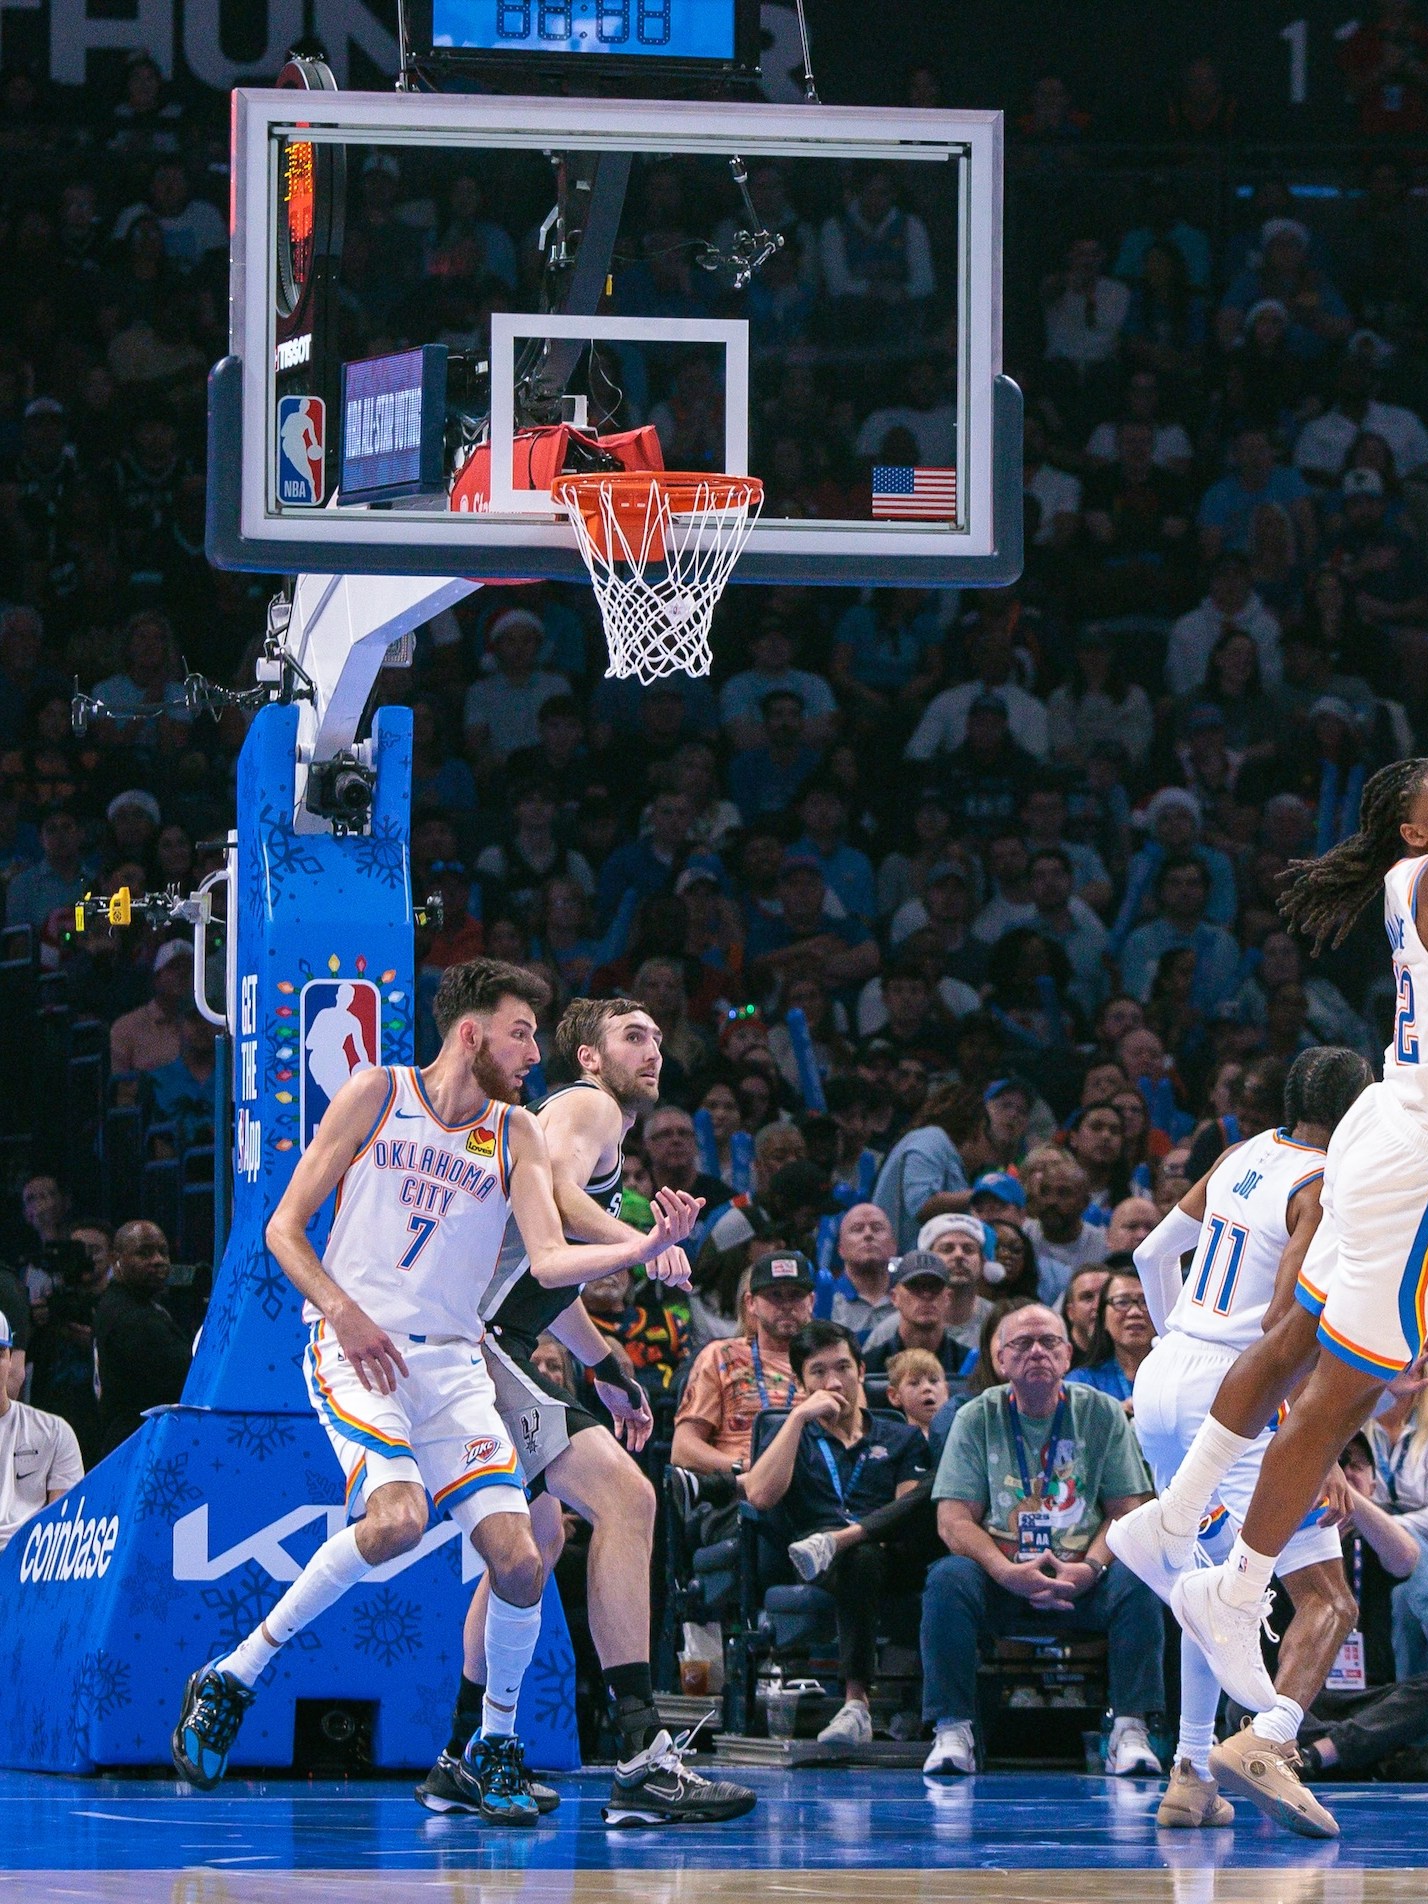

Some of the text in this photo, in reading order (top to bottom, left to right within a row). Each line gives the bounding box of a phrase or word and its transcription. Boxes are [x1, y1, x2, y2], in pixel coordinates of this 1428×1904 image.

[278, 333, 312, 370] TISSOT
[284, 480, 306, 498] NBA
[242, 974, 258, 1036] GET
[1392, 958, 1421, 1066] 2
[241, 1040, 257, 1101] THE
[244, 1108, 261, 1183] App
[373, 1139, 497, 1203] OKLAHOMA
[399, 1176, 457, 1217] CITY
[1232, 1168, 1263, 1200] JOE
[397, 1213, 439, 1271] 7
[1191, 1212, 1250, 1318] 11
[466, 1441, 493, 1464] OKC
[20, 1496, 120, 1584] coinbase
